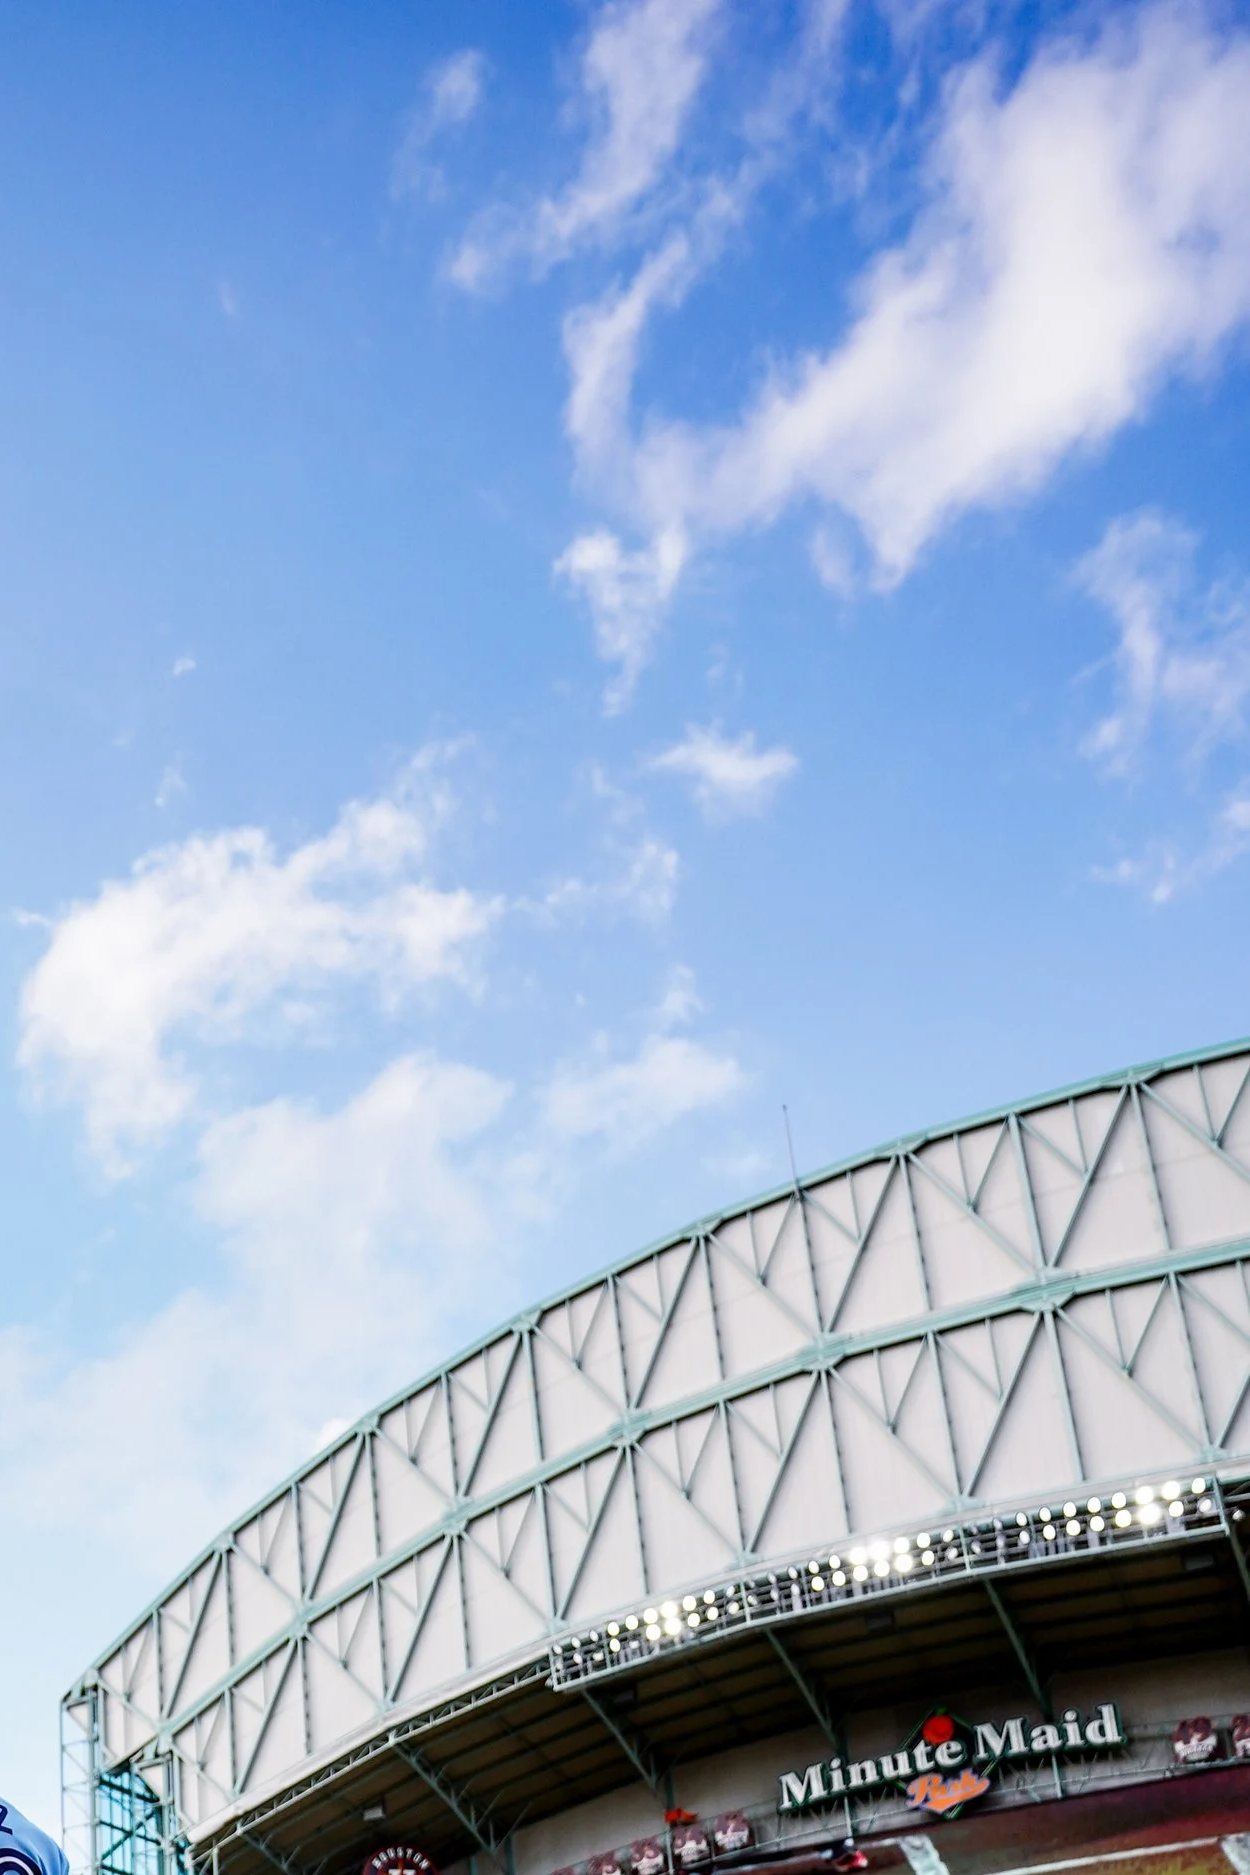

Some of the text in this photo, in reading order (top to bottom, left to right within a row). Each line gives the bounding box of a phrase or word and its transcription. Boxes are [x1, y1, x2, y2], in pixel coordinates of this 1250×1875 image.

[778, 1703, 1123, 1809] Minute Maid
[907, 1768, 991, 1813] Park
[372, 1847, 430, 1869] HOUSTON
